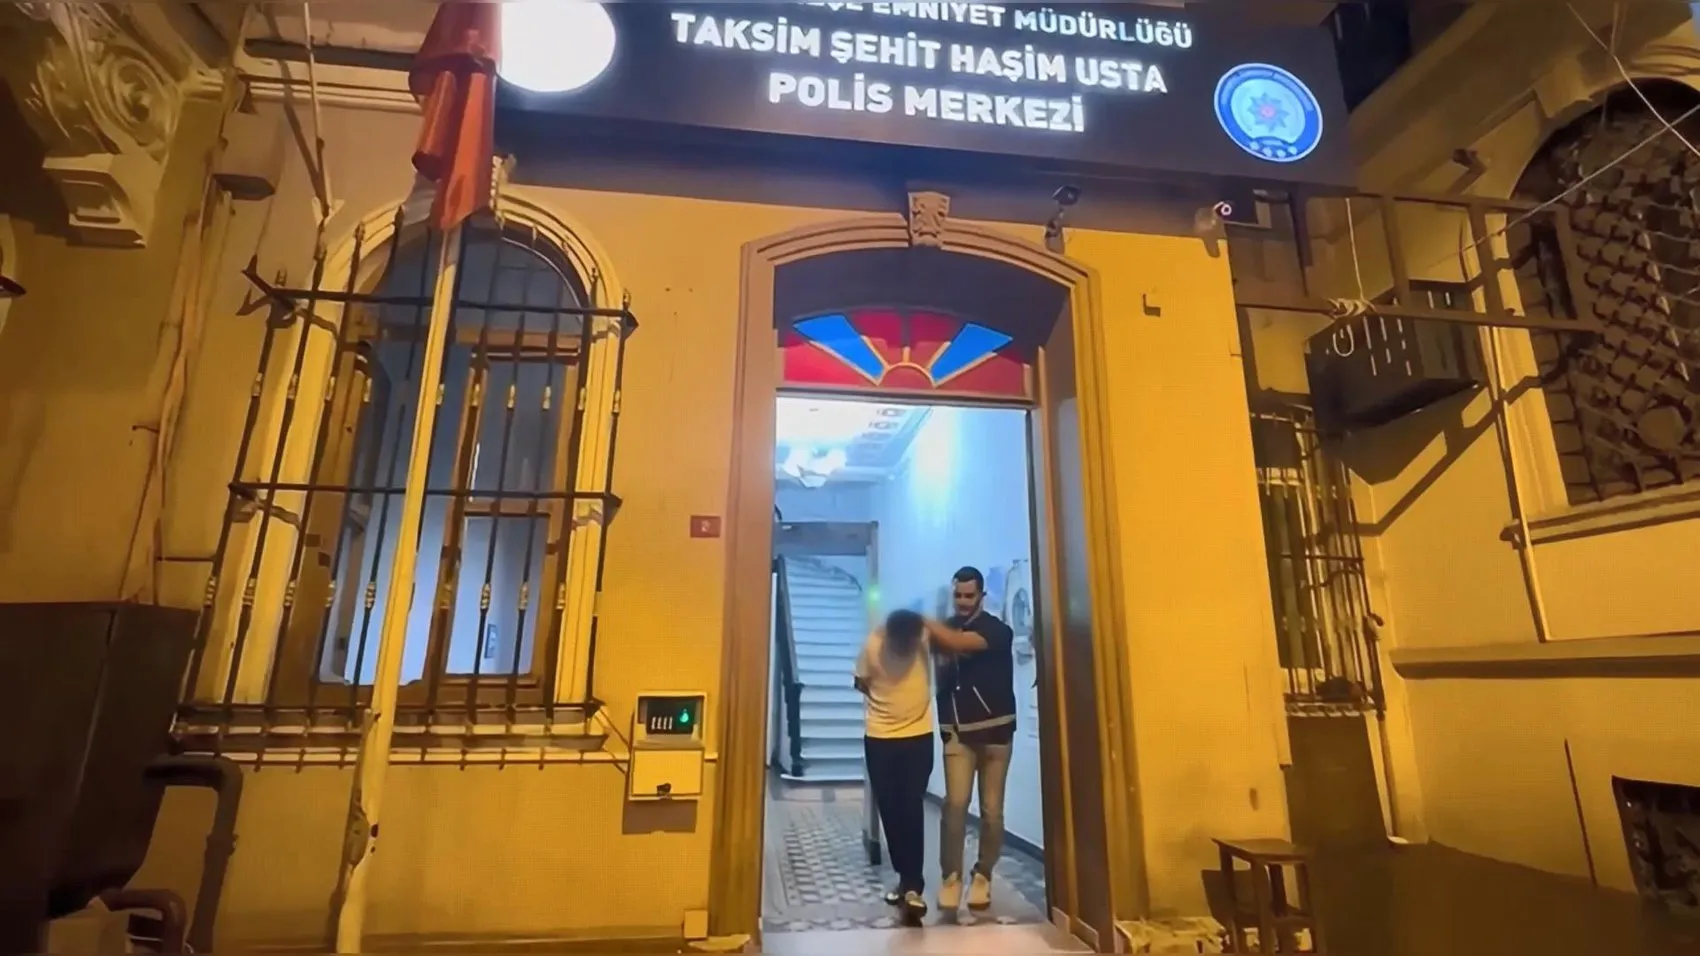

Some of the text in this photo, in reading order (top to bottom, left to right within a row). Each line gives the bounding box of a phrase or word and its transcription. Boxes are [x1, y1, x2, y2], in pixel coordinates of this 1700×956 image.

[671, 12, 1168, 93] TAKSİM ŞEHİT HAŞİM USTA
[1014, 8, 1193, 48] MÜDÜRLÜĞÜ
[769, 72, 1085, 132] POLİS MERKEZİ
